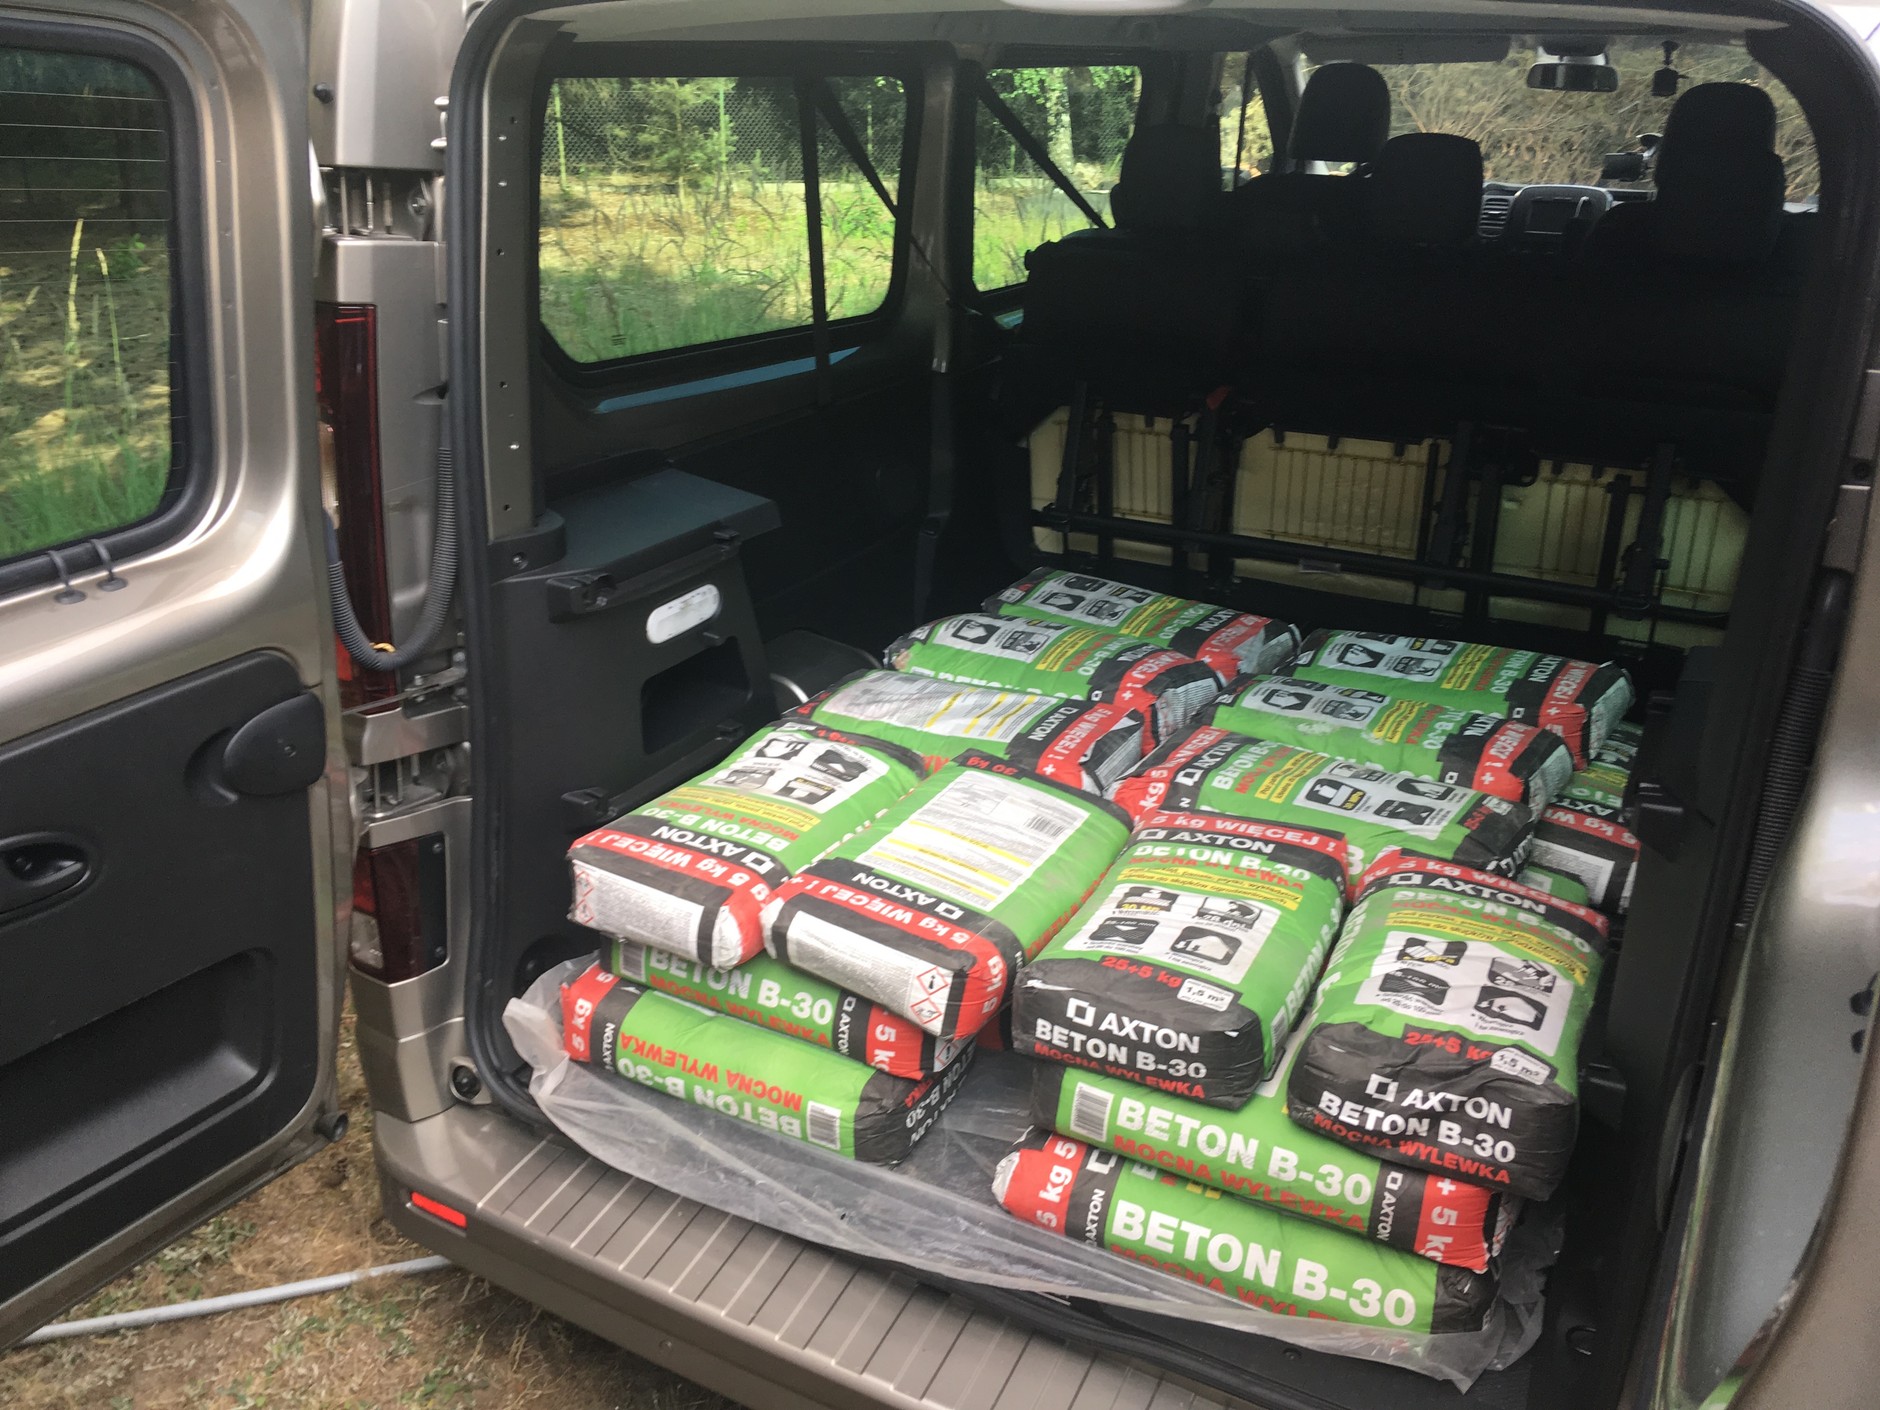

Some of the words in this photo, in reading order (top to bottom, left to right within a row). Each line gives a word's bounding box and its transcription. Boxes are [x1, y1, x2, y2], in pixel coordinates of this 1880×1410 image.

[642, 807, 699, 827] B-30
[702, 819, 791, 851] BETON
[739, 816, 799, 841] MOCNA
[1173, 814, 1206, 828] kg
[1215, 820, 1320, 846] WIĘCEJ
[601, 833, 693, 868] WIĘCEJ
[651, 825, 747, 857] AXTON
[1170, 830, 1275, 854] AXTON
[696, 861, 729, 878] kg
[727, 872, 750, 887] 5
[1426, 861, 1461, 876] kg
[819, 885, 914, 925] WIĘCEJ
[852, 872, 937, 907] AXTON
[1428, 877, 1547, 914] AXTON
[918, 917, 951, 937] kg
[951, 932, 971, 944] 5
[649, 951, 751, 999] BETON
[757, 978, 832, 1026] B-30
[1102, 956, 1154, 979] 25+5
[1155, 970, 1182, 988] kg
[572, 998, 592, 1030] kg
[649, 973, 722, 1010] MOCNA
[726, 1000, 831, 1048] WYLEWKA
[838, 1013, 852, 1055] AXTON
[875, 1024, 896, 1042] 5
[1035, 1018, 1127, 1065] BETON
[1136, 1050, 1207, 1079] B-30
[1098, 1012, 1200, 1054] AXTON
[619, 1030, 718, 1083] WYLEWKA
[1034, 1041, 1106, 1070] MOCNA
[1105, 1064, 1206, 1099] WYLEWKA
[617, 1057, 687, 1099] B-30
[726, 1069, 803, 1112] MOCNA
[693, 1084, 803, 1139] BETON
[1318, 1090, 1429, 1137] BETON
[1437, 1119, 1515, 1163] B-30
[1402, 1087, 1512, 1129] AXTON
[1054, 1140, 1077, 1159] 5
[1115, 1096, 1257, 1171] BETON
[1269, 1148, 1373, 1205] B-30
[1312, 1112, 1393, 1149] MOCNA
[1398, 1139, 1511, 1185] WYLEWKA
[1038, 1165, 1073, 1203] kg
[1113, 1134, 1212, 1183] MOCNA
[1220, 1169, 1368, 1233] WYLEWKA
[1376, 1192, 1397, 1242] AXTON
[1431, 1206, 1459, 1226] 5
[1111, 1199, 1283, 1289] BETON
[1292, 1258, 1417, 1327] B-30
